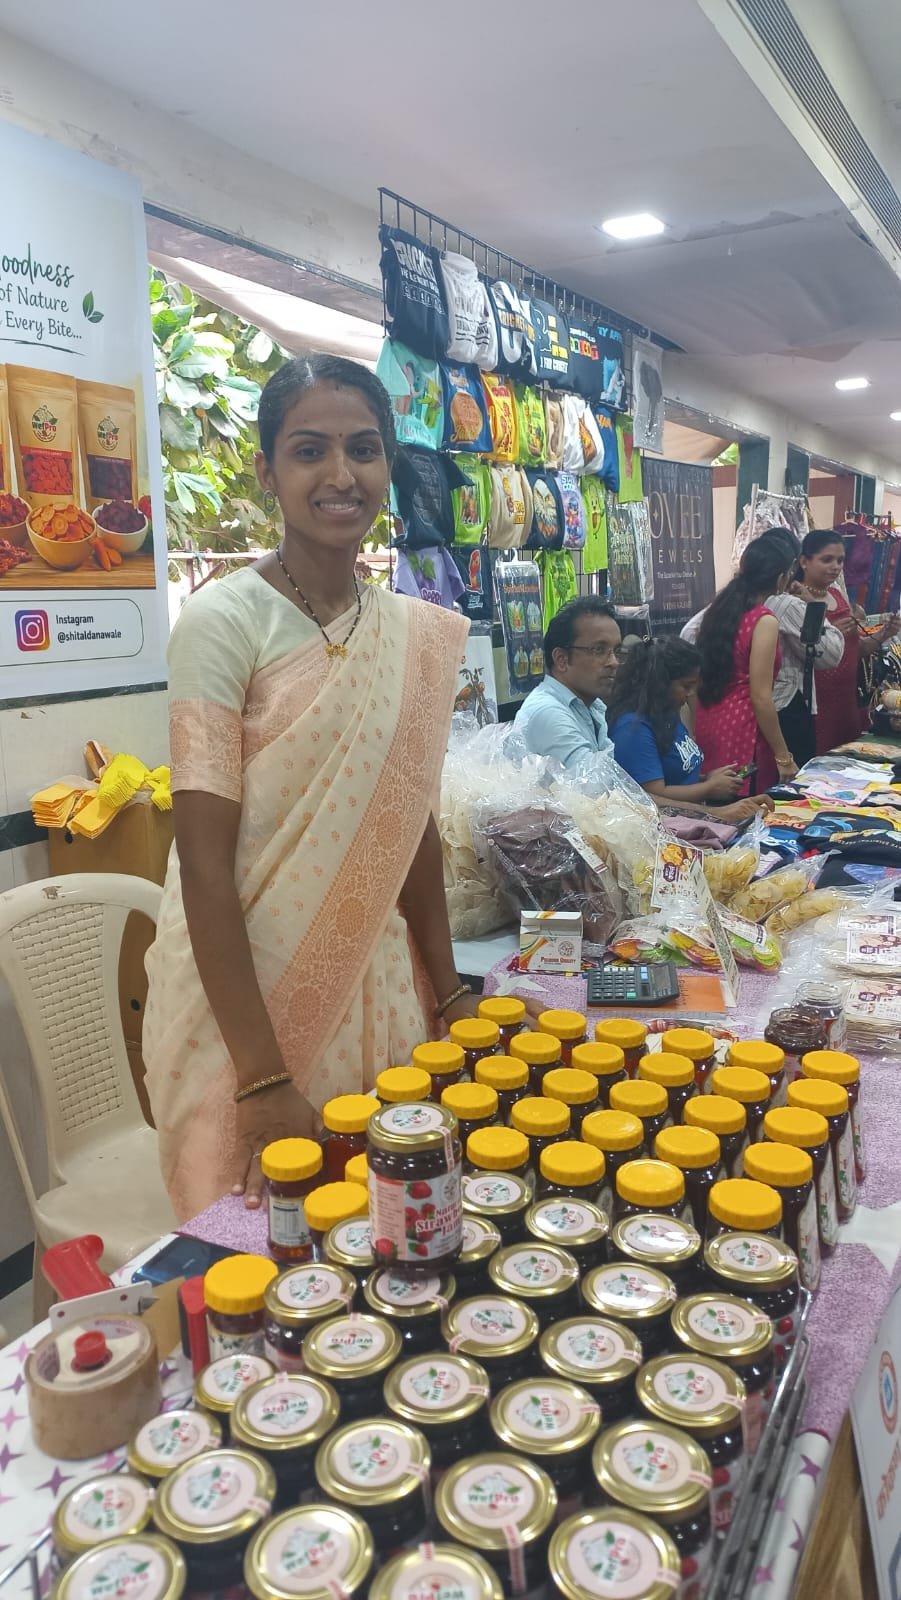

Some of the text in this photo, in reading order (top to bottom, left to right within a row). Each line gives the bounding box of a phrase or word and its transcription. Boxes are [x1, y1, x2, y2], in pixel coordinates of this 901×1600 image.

[0, 242, 75, 288] oodness
[17, 285, 70, 313] Nature
[5, 310, 82, 340] Every Bite...
[658, 549, 703, 564] EWELS
[55, 614, 94, 626] Instagram
[57, 629, 122, 643] @shitaldanawale
